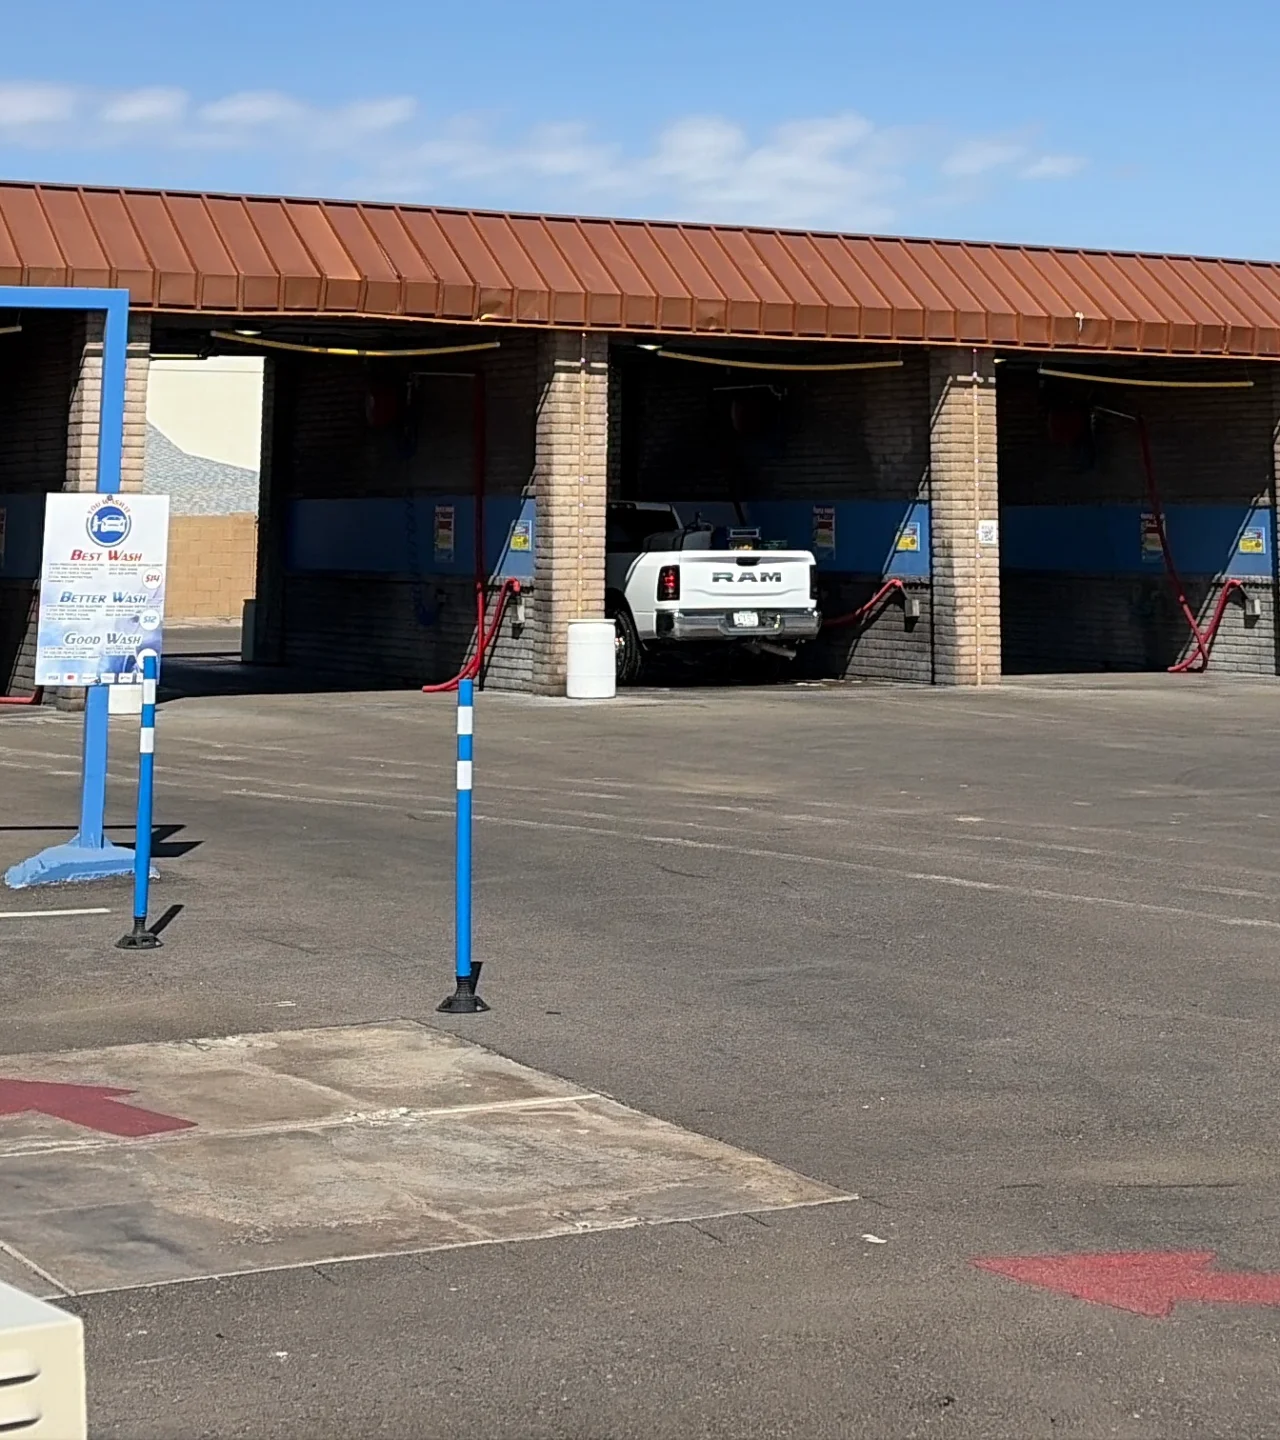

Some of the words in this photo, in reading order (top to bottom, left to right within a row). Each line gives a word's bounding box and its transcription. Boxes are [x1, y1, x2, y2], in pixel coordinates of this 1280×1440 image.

[70, 549, 103, 561] BEST
[108, 550, 143, 561] WASH
[712, 572, 781, 582] RAM
[60, 591, 107, 603] BETTER
[112, 591, 147, 603] WASH
[64, 633, 101, 645] GOOD
[107, 633, 141, 645] WASH
